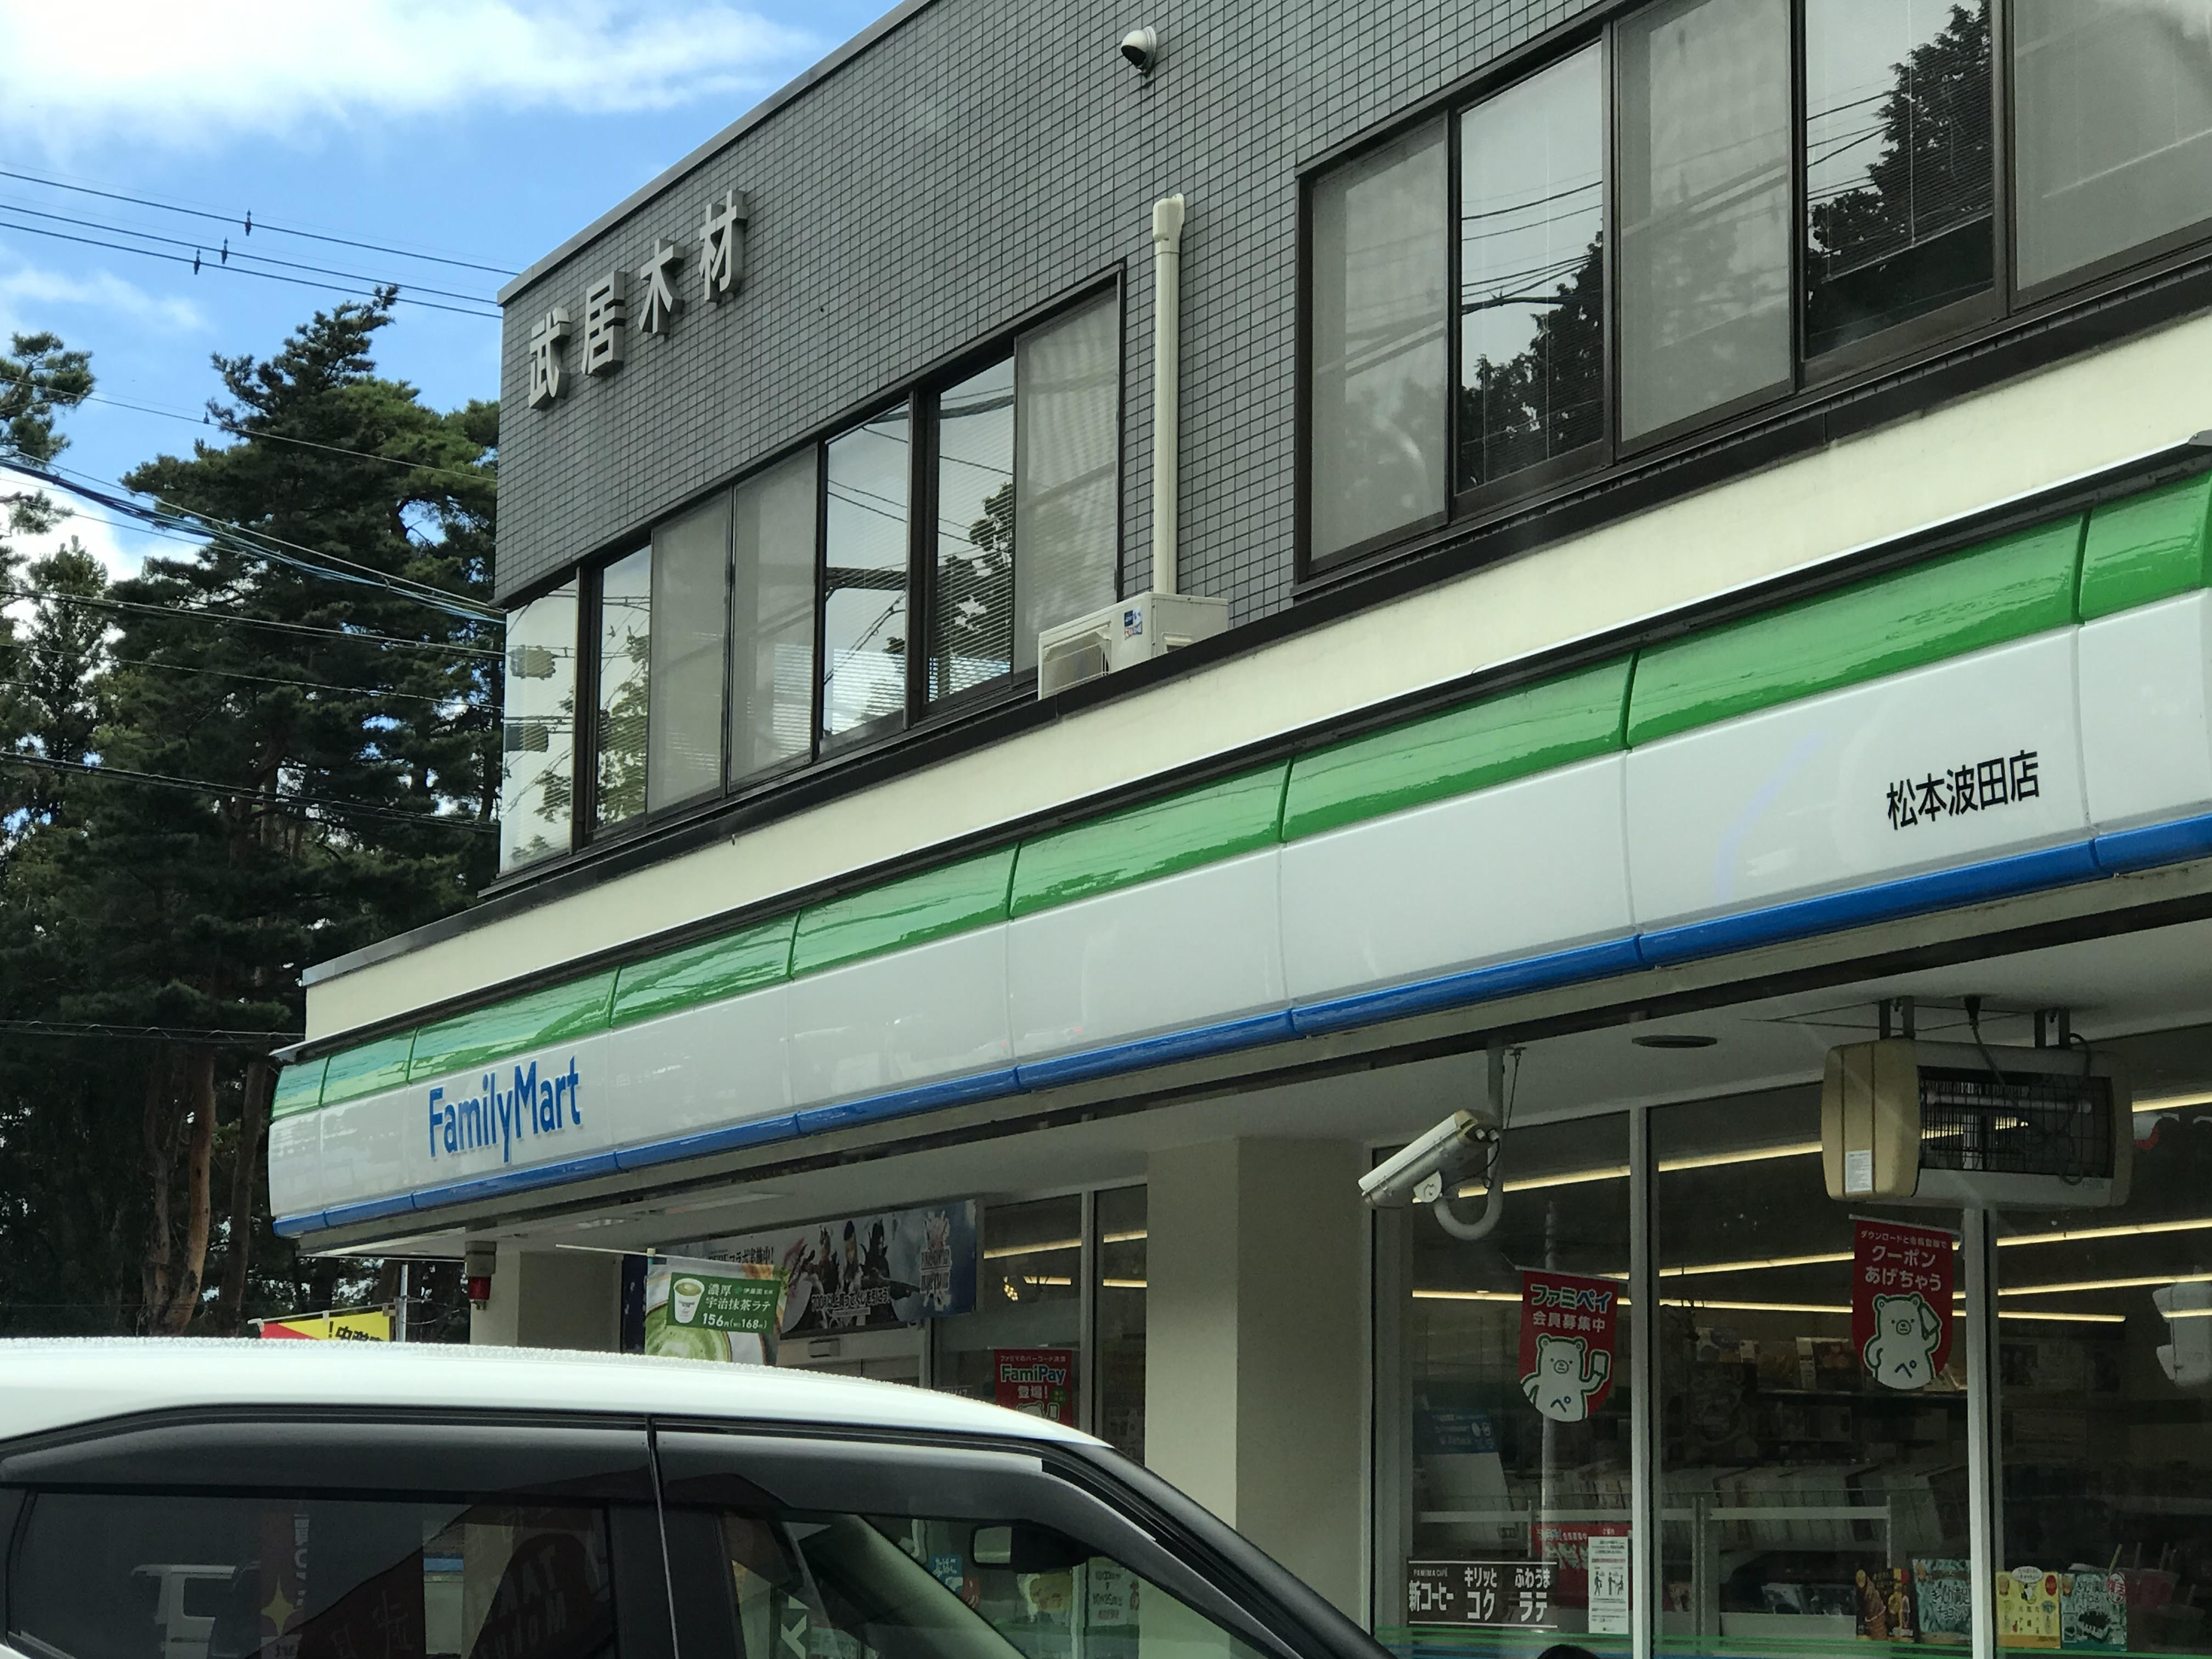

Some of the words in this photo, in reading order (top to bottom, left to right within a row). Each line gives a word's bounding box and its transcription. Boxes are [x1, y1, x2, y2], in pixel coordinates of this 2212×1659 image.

[528, 189, 748, 410] 武居木材
[1887, 749, 2039, 830] 松本波田店
[429, 1056, 581, 1163] FamilyMart
[1872, 1245, 1936, 1267] クーポン
[708, 1283, 732, 1296] 濃厚
[1865, 1266, 1942, 1291] あげちゃう
[706, 1297, 771, 1312] 宇治抹茶ラテ
[1531, 1284, 1612, 1313] ファミペイ
[1533, 1311, 1605, 1332] 会員募集中
[1000, 1364, 1066, 1385] FamiPay
[1464, 1567, 1497, 1587] キリッと
[1515, 1568, 1550, 1588] ふわうま
[1409, 1580, 1454, 1611] 新コーヒー
[1468, 1589, 1495, 1620] コク
[1520, 1592, 1548, 1621] ラテ
